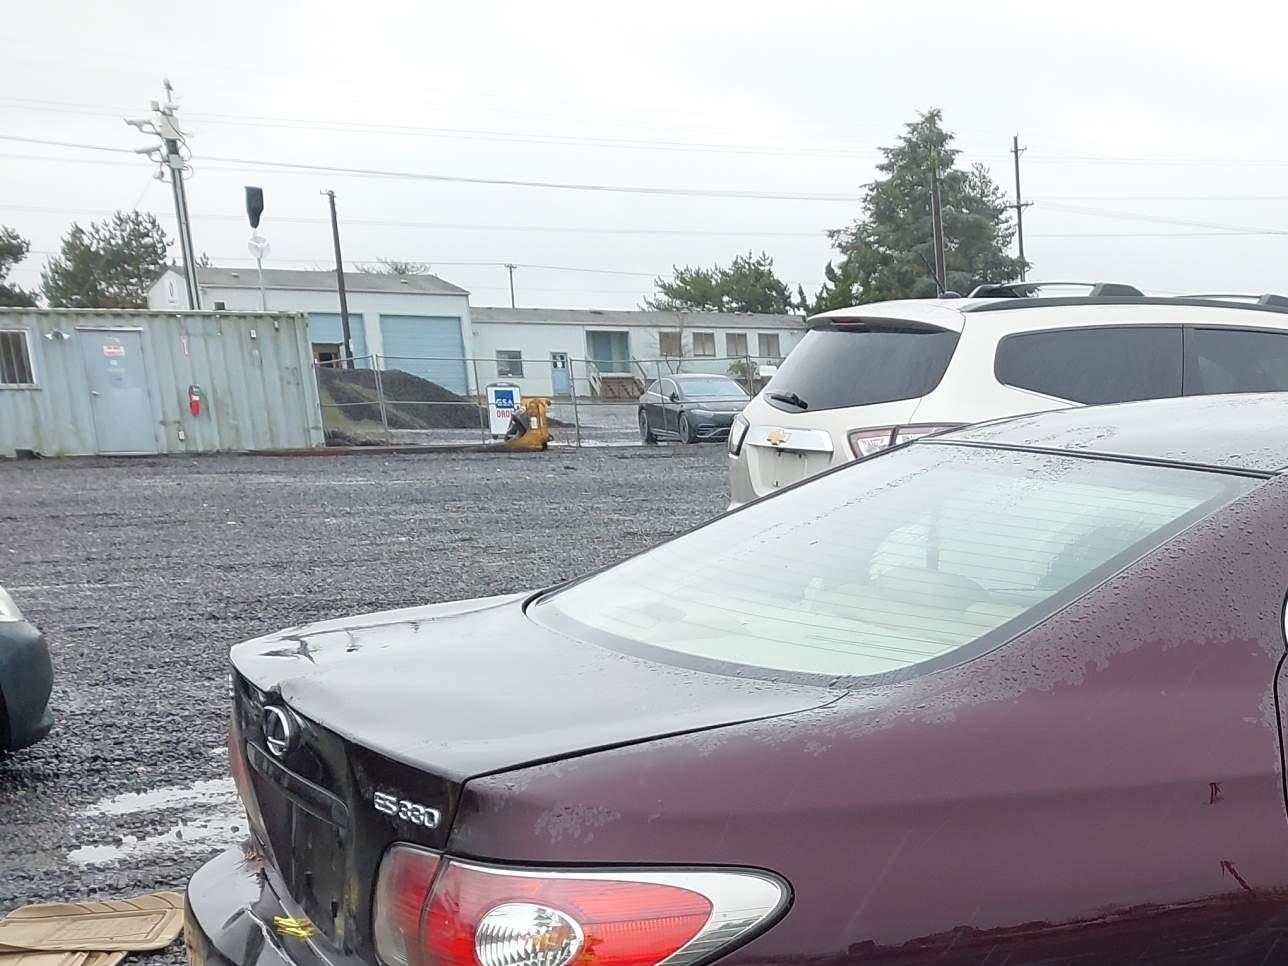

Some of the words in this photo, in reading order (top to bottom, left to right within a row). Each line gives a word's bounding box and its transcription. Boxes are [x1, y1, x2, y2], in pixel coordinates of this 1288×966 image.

[495, 398, 513, 407] GSA
[374, 792, 398, 816] ES
[399, 801, 441, 829] 330
